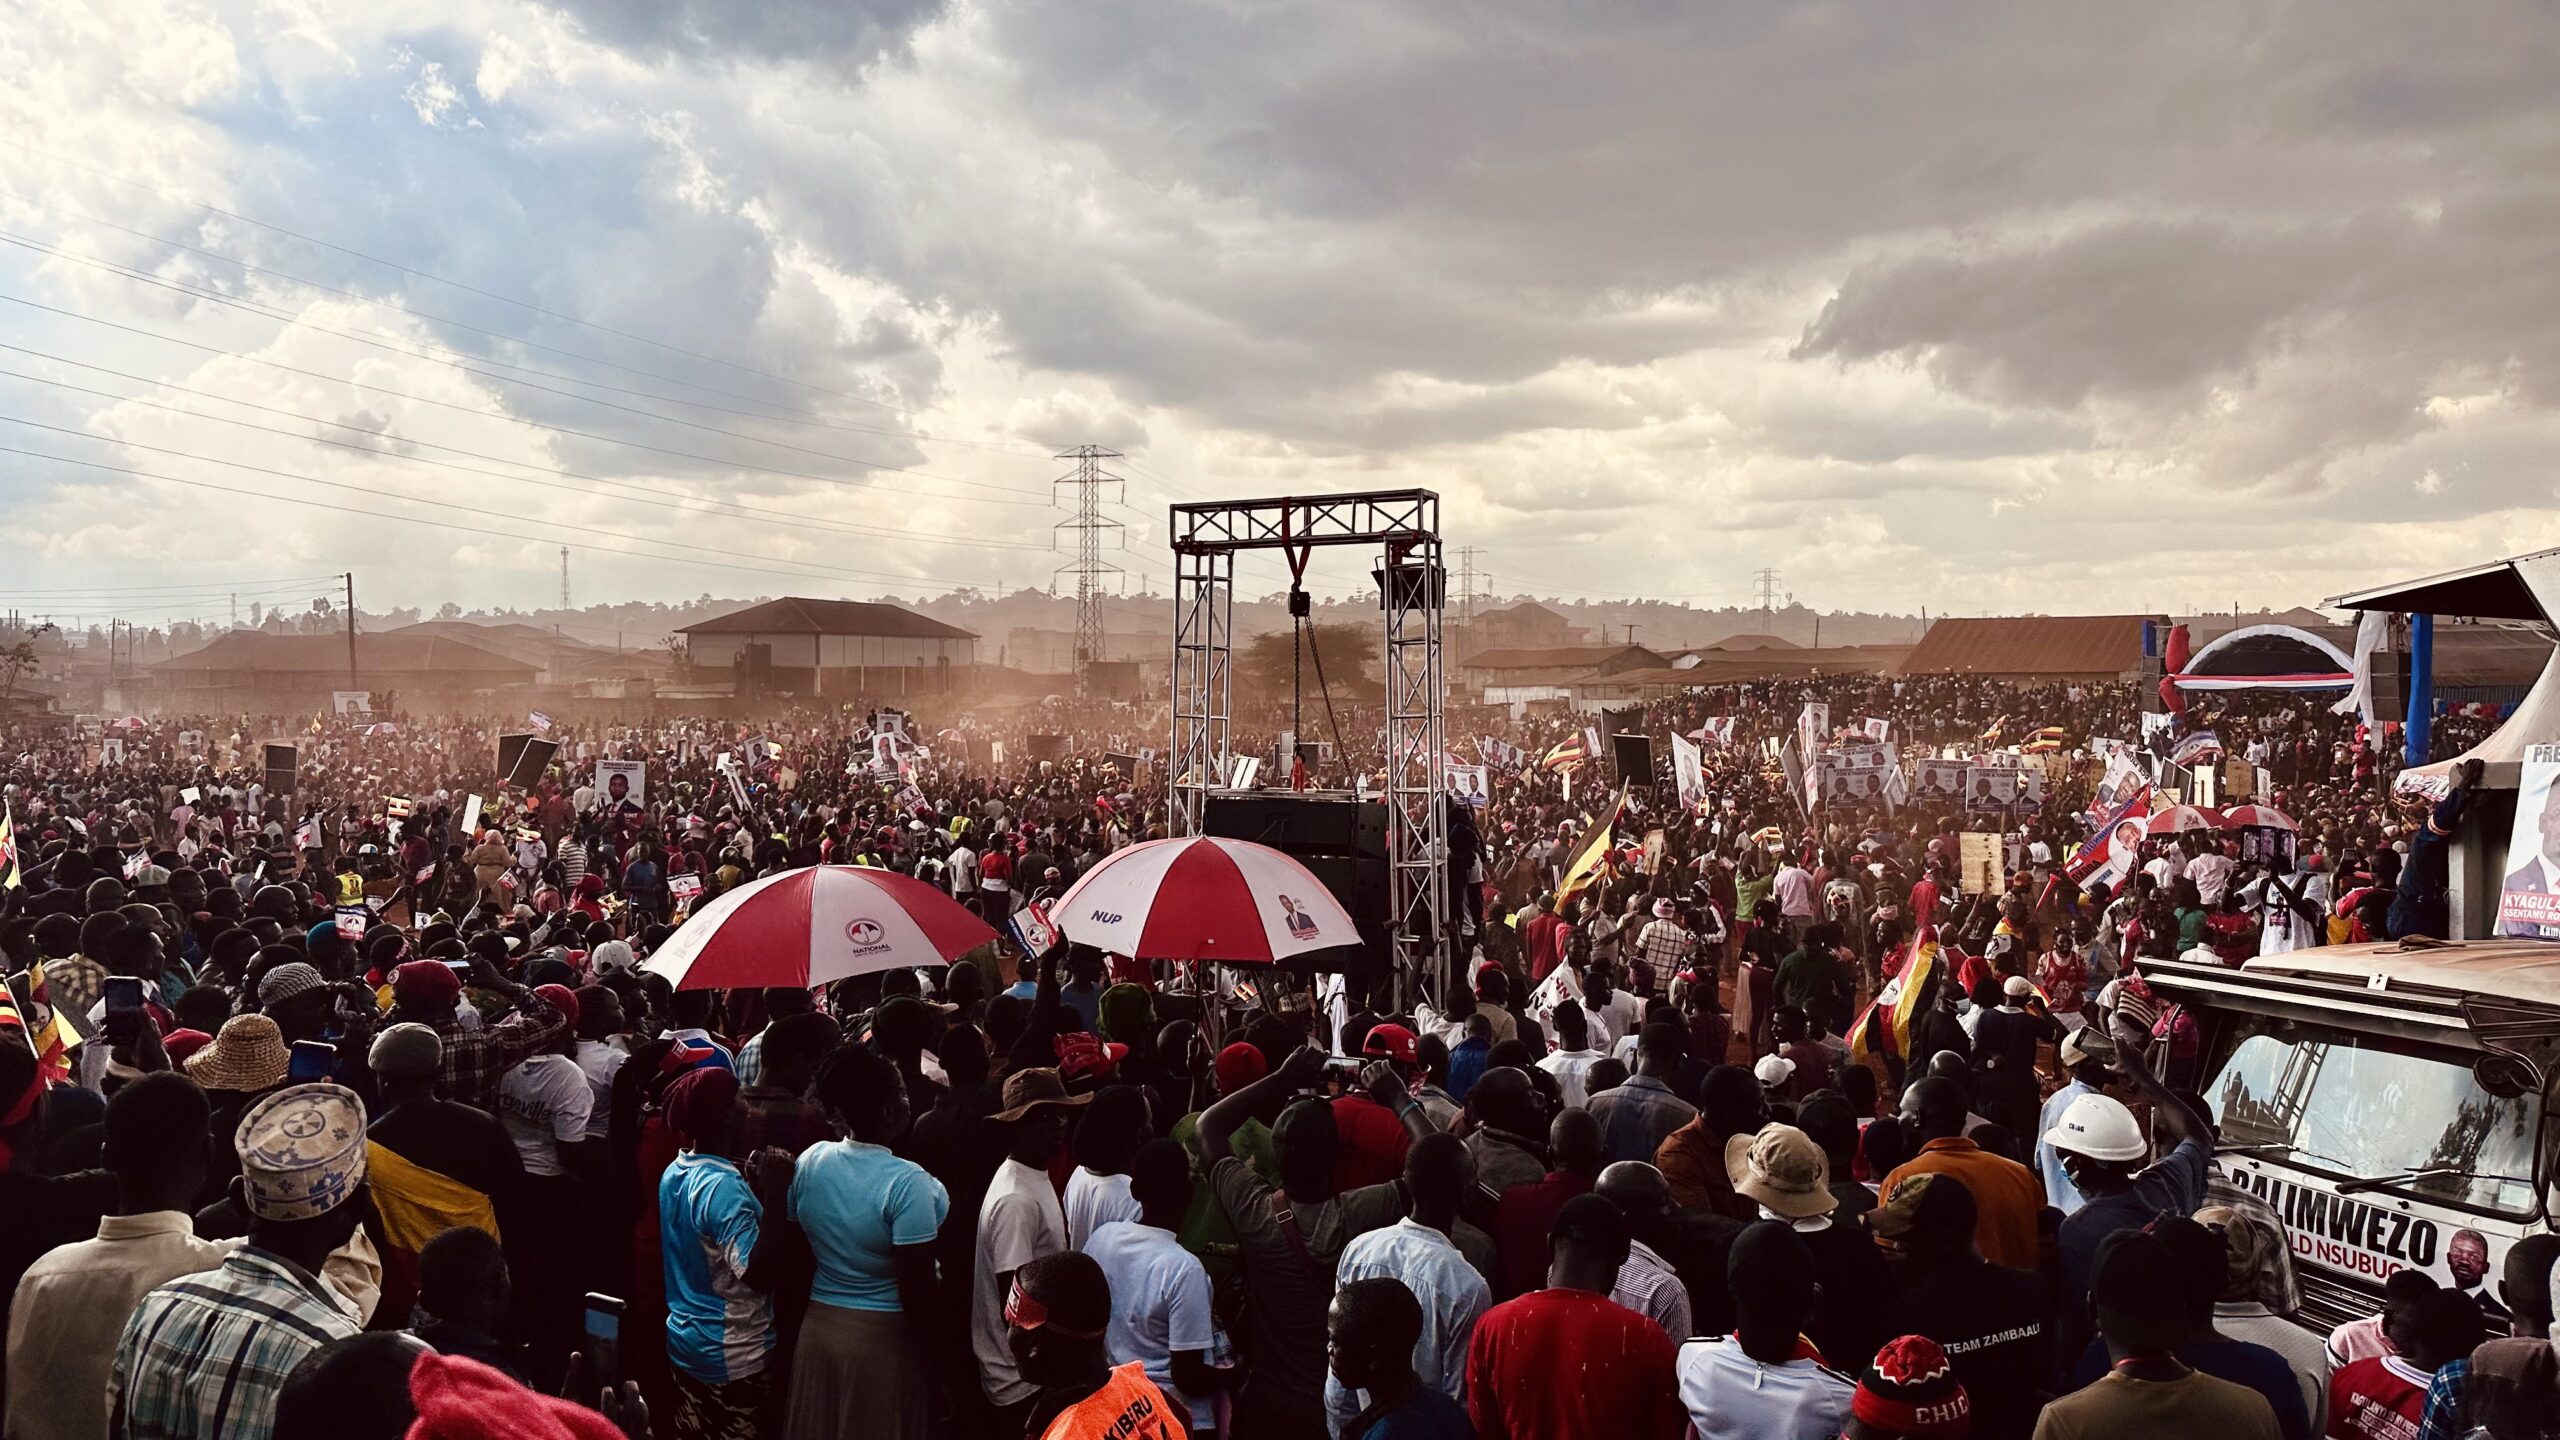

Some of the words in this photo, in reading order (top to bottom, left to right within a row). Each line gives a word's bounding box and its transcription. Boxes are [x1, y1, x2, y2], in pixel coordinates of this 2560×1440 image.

[2533, 746, 2560, 763] PRE
[1091, 910, 1122, 925] NUP
[2503, 908, 2546, 919] SSENTAMU
[2539, 924, 2560, 939] Kam
[853, 944, 891, 954] NATIONAL
[1943, 1338, 1981, 1355] TEAM
